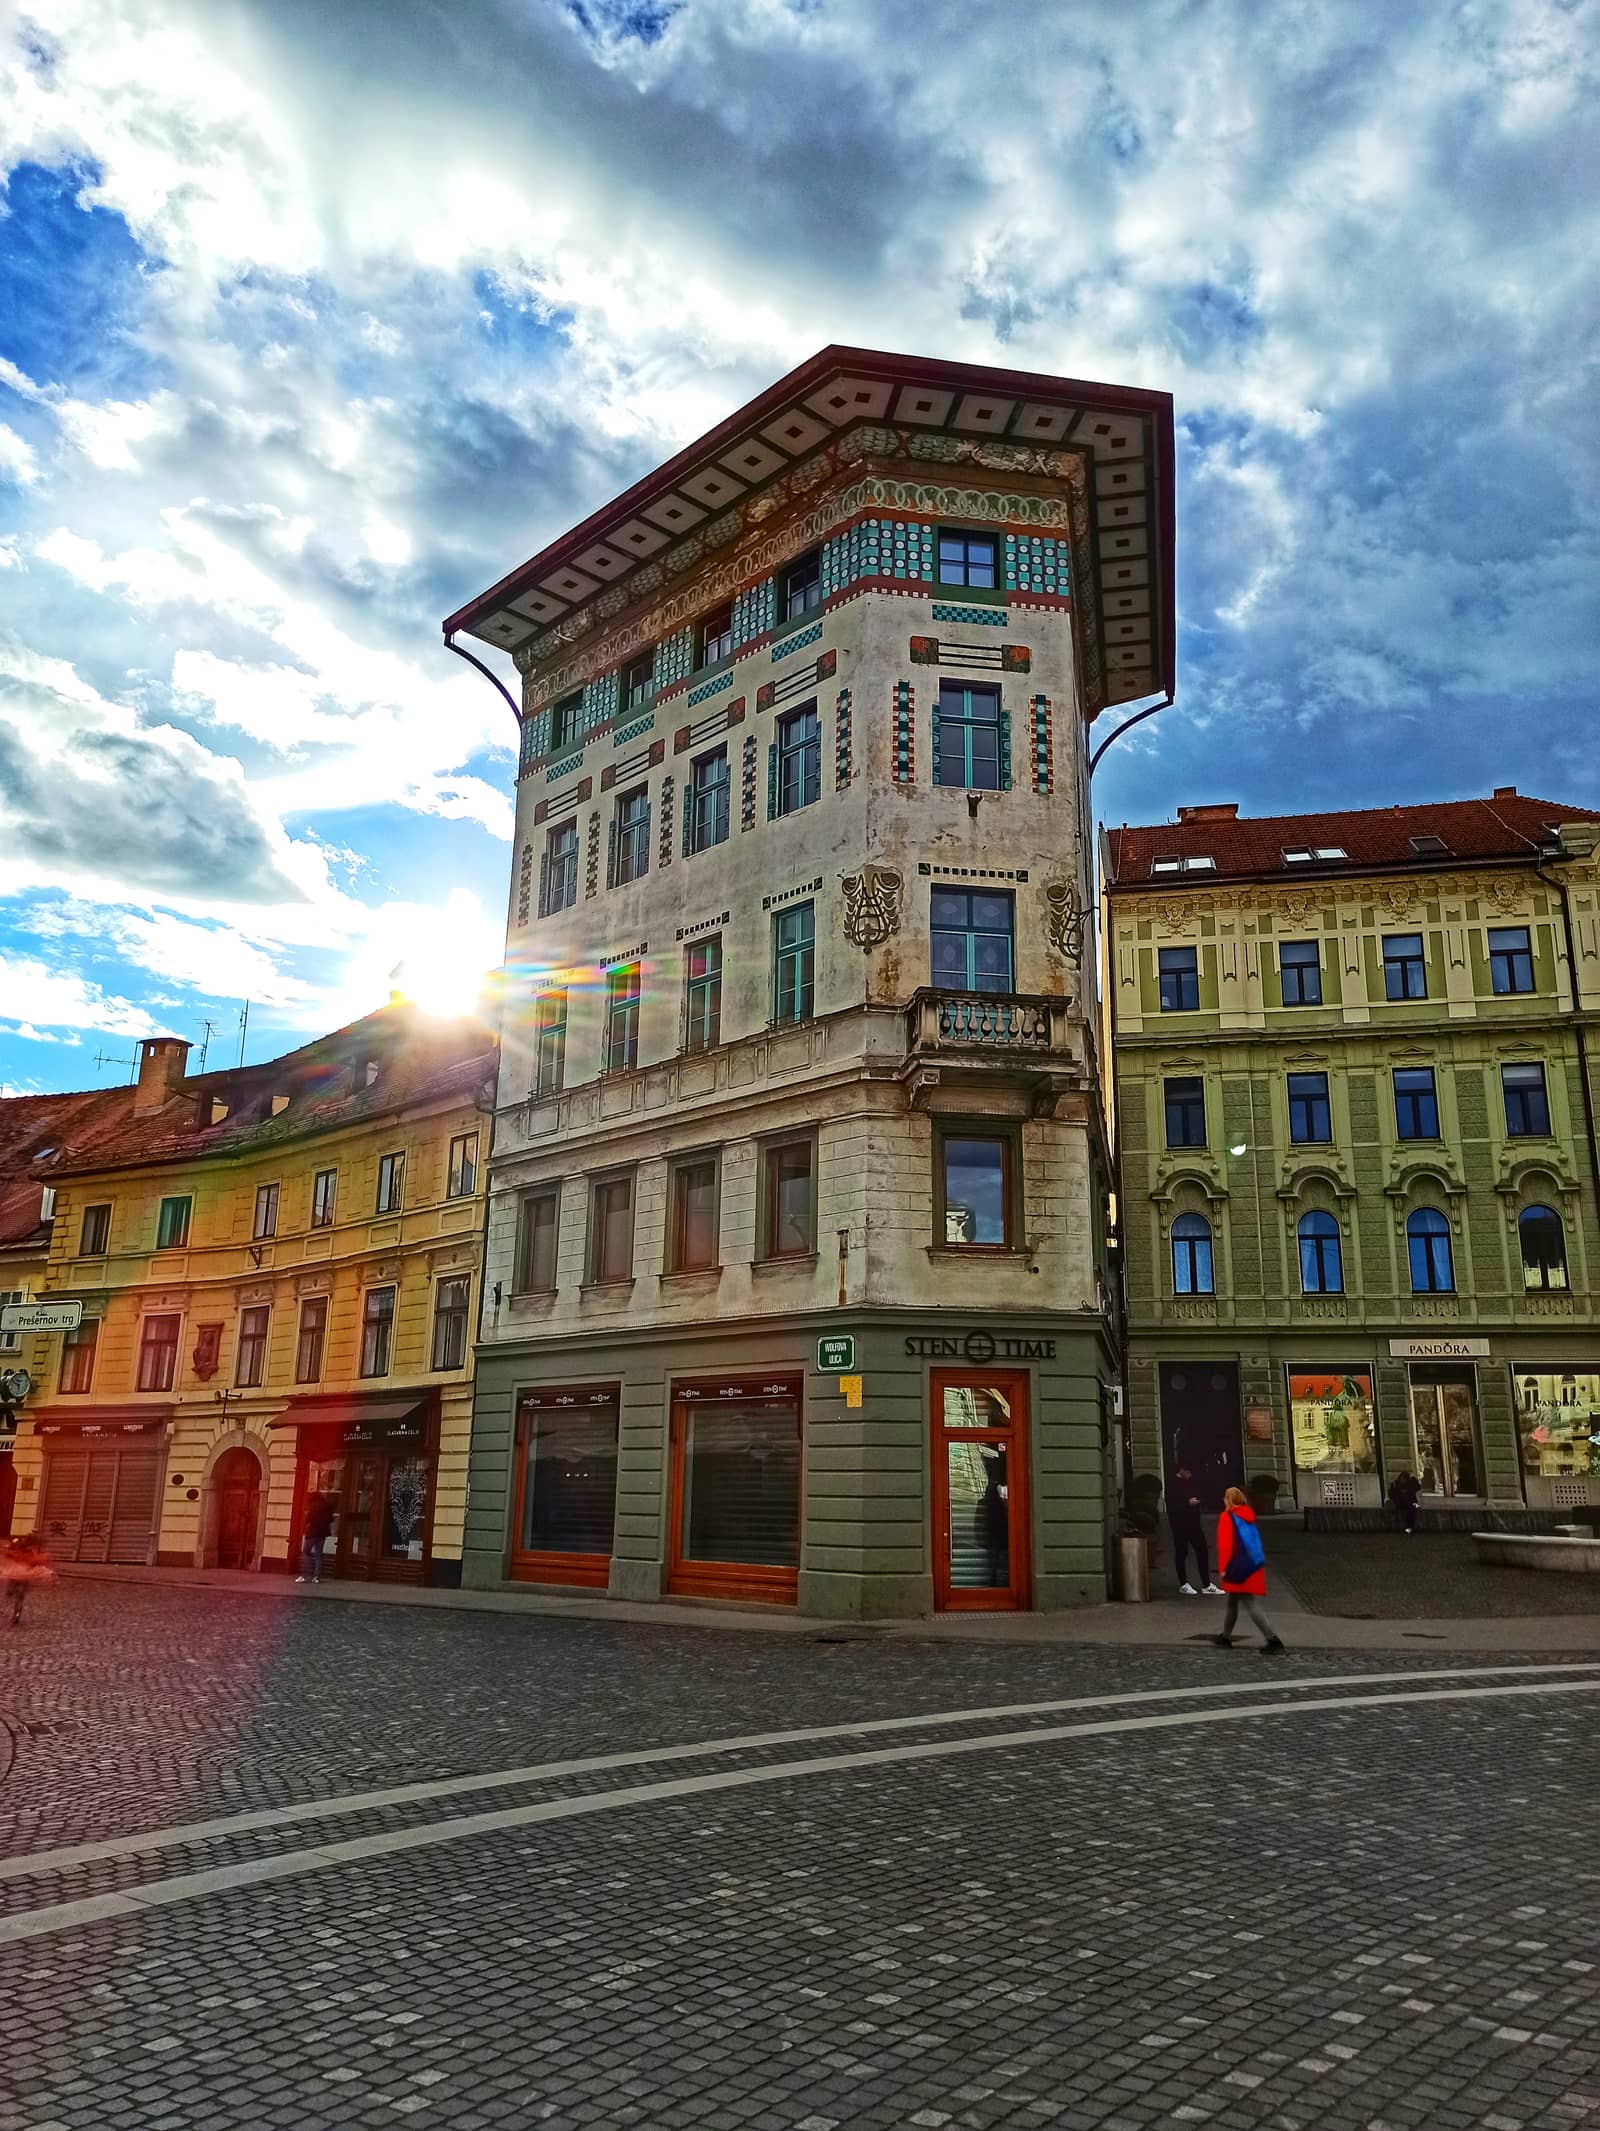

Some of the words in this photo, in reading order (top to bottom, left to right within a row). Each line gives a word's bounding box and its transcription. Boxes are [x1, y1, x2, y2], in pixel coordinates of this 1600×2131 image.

[18, 1315, 59, 1326] Prešernov
[62, 1315, 74, 1326] trg
[824, 1342, 847, 1353] WOLFOVA
[905, 1336, 958, 1357] STEN
[1001, 1338, 1057, 1359] TIME
[1409, 1342, 1470, 1355] PANDORA
[828, 1354, 843, 1365] ULICA
[1310, 1399, 1353, 1407] PANDORA
